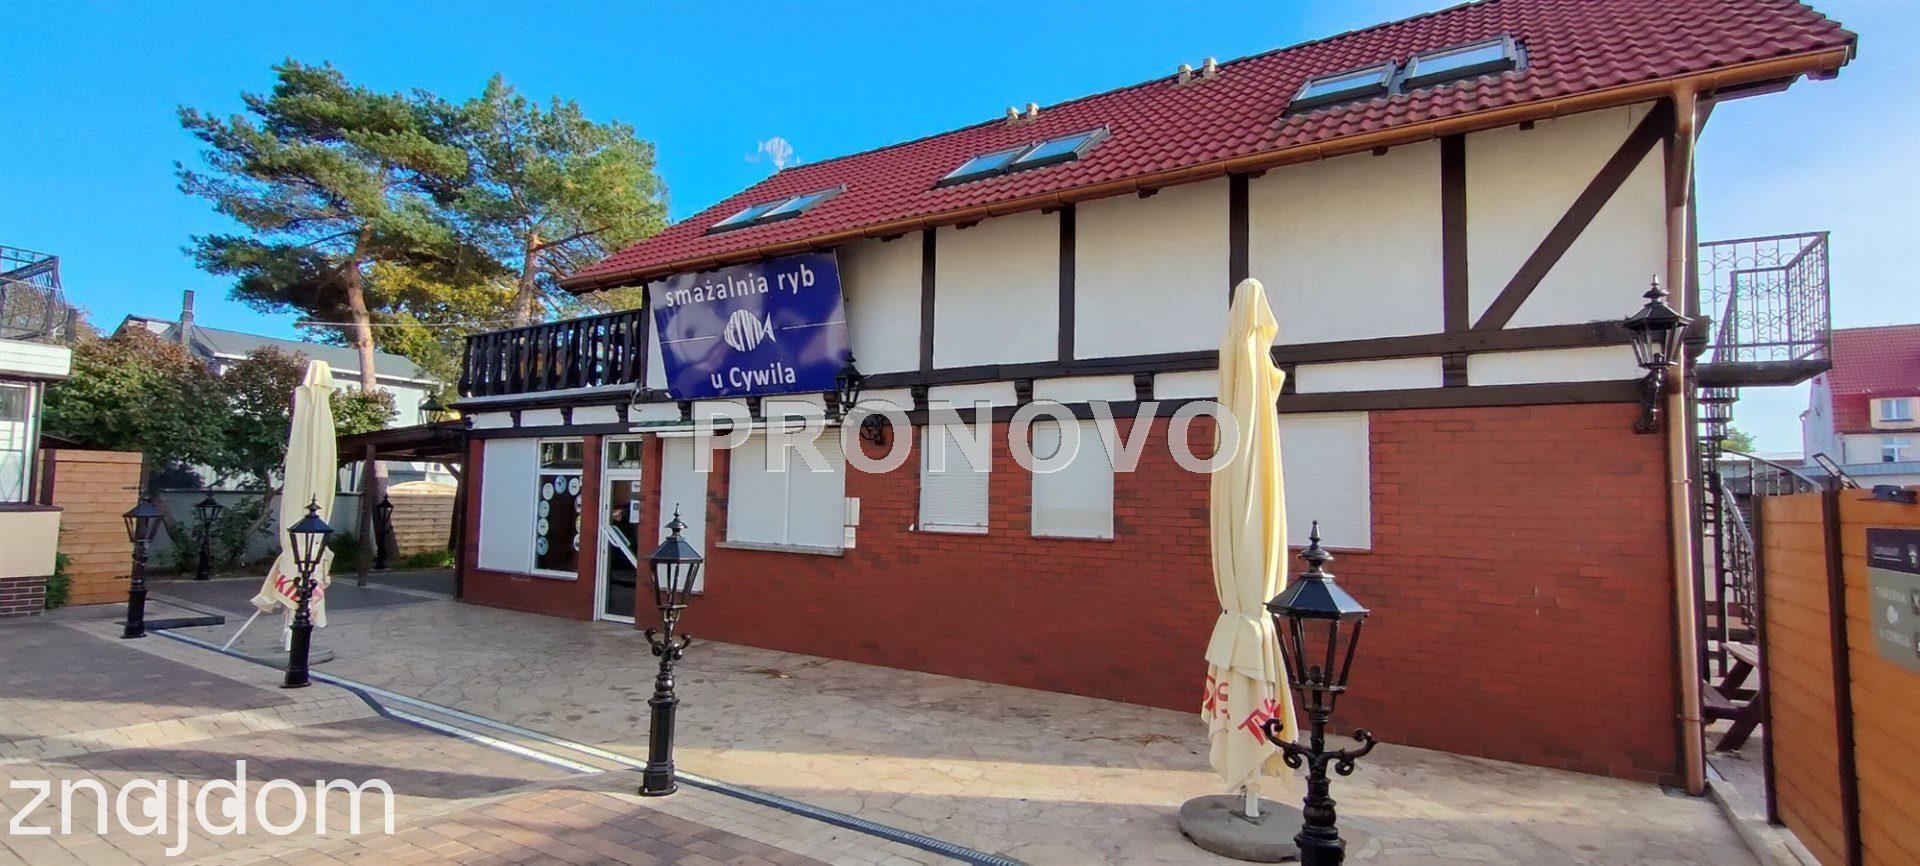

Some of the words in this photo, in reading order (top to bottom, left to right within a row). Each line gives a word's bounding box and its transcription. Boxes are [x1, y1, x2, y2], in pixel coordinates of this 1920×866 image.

[665, 275, 769, 307] smażalnia
[777, 264, 815, 294] ryb
[710, 372, 723, 389] u
[729, 362, 796, 391] Cywila
